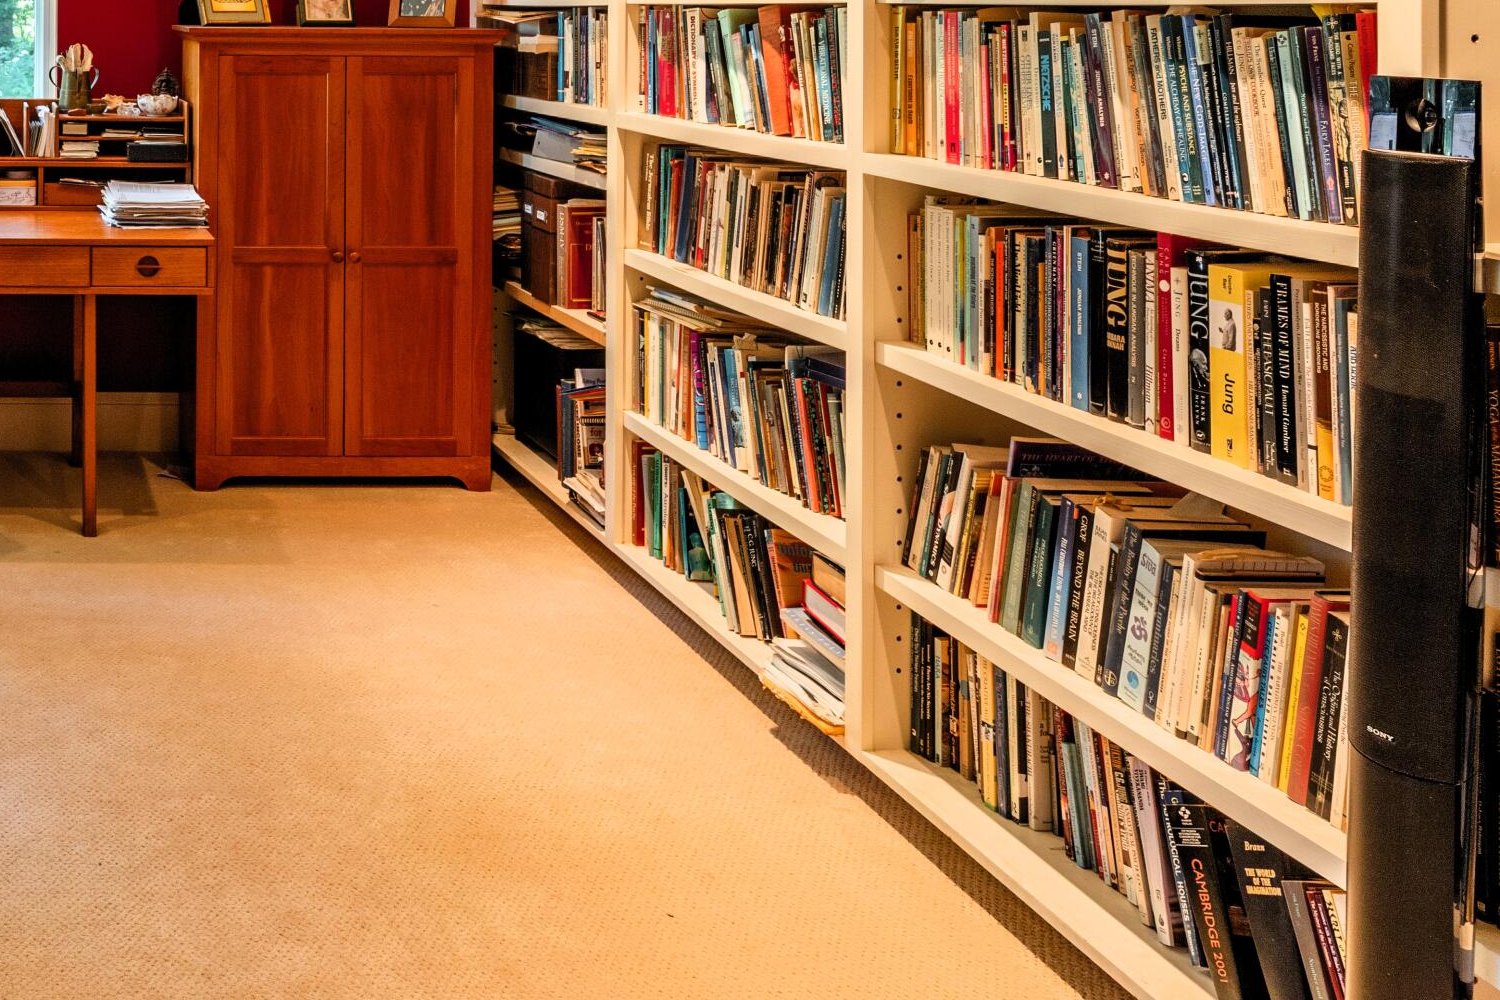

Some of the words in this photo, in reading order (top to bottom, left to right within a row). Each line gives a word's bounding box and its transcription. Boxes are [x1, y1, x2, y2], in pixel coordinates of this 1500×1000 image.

[1226, 41, 1234, 75] HILLMAN
[1150, 28, 1160, 63] FATHERS
[1156, 80, 1167, 120] MOTHERS
[1178, 65, 1188, 93] PSYCHE
[1182, 95, 1191, 112] AND
[1175, 128, 1187, 162] HEALING
[1184, 113, 1196, 155] SUBSTANCE
[1174, 290, 1183, 317] JUNG
[1188, 271, 1209, 339] JUNG
[1275, 281, 1289, 328] FRAMES
[1278, 331, 1289, 348] OF
[1277, 348, 1290, 379] MIND
[1223, 373, 1235, 415] Jung
[1280, 384, 1290, 417] Howard
[1282, 418, 1291, 453] Gardner
[1079, 515, 1088, 543] GROF
[1129, 531, 1138, 549] The
[1074, 550, 1085, 588] BEYOND
[1123, 550, 1135, 577] Reality
[1072, 590, 1080, 611] THE
[1121, 591, 1129, 604] the
[1122, 580, 1130, 591] of
[1068, 611, 1078, 642] BRAIN
[1116, 605, 1127, 635] Psyche
[1149, 603, 1166, 674] Luminaries
[1323, 676, 1329, 685] of
[1317, 686, 1330, 744] Consciousness
[1329, 685, 1339, 715] Origins
[1324, 730, 1335, 761] History
[1366, 725, 1395, 742] SONY
[1244, 868, 1256, 877] THE
[1256, 868, 1276, 878] WORLD
[1252, 878, 1260, 886] OF
[1260, 878, 1272, 886] THE
[1176, 880, 1190, 922] HOUSES
[1190, 858, 1221, 949] CAMBRIDGE
[1212, 952, 1228, 984] 2001
